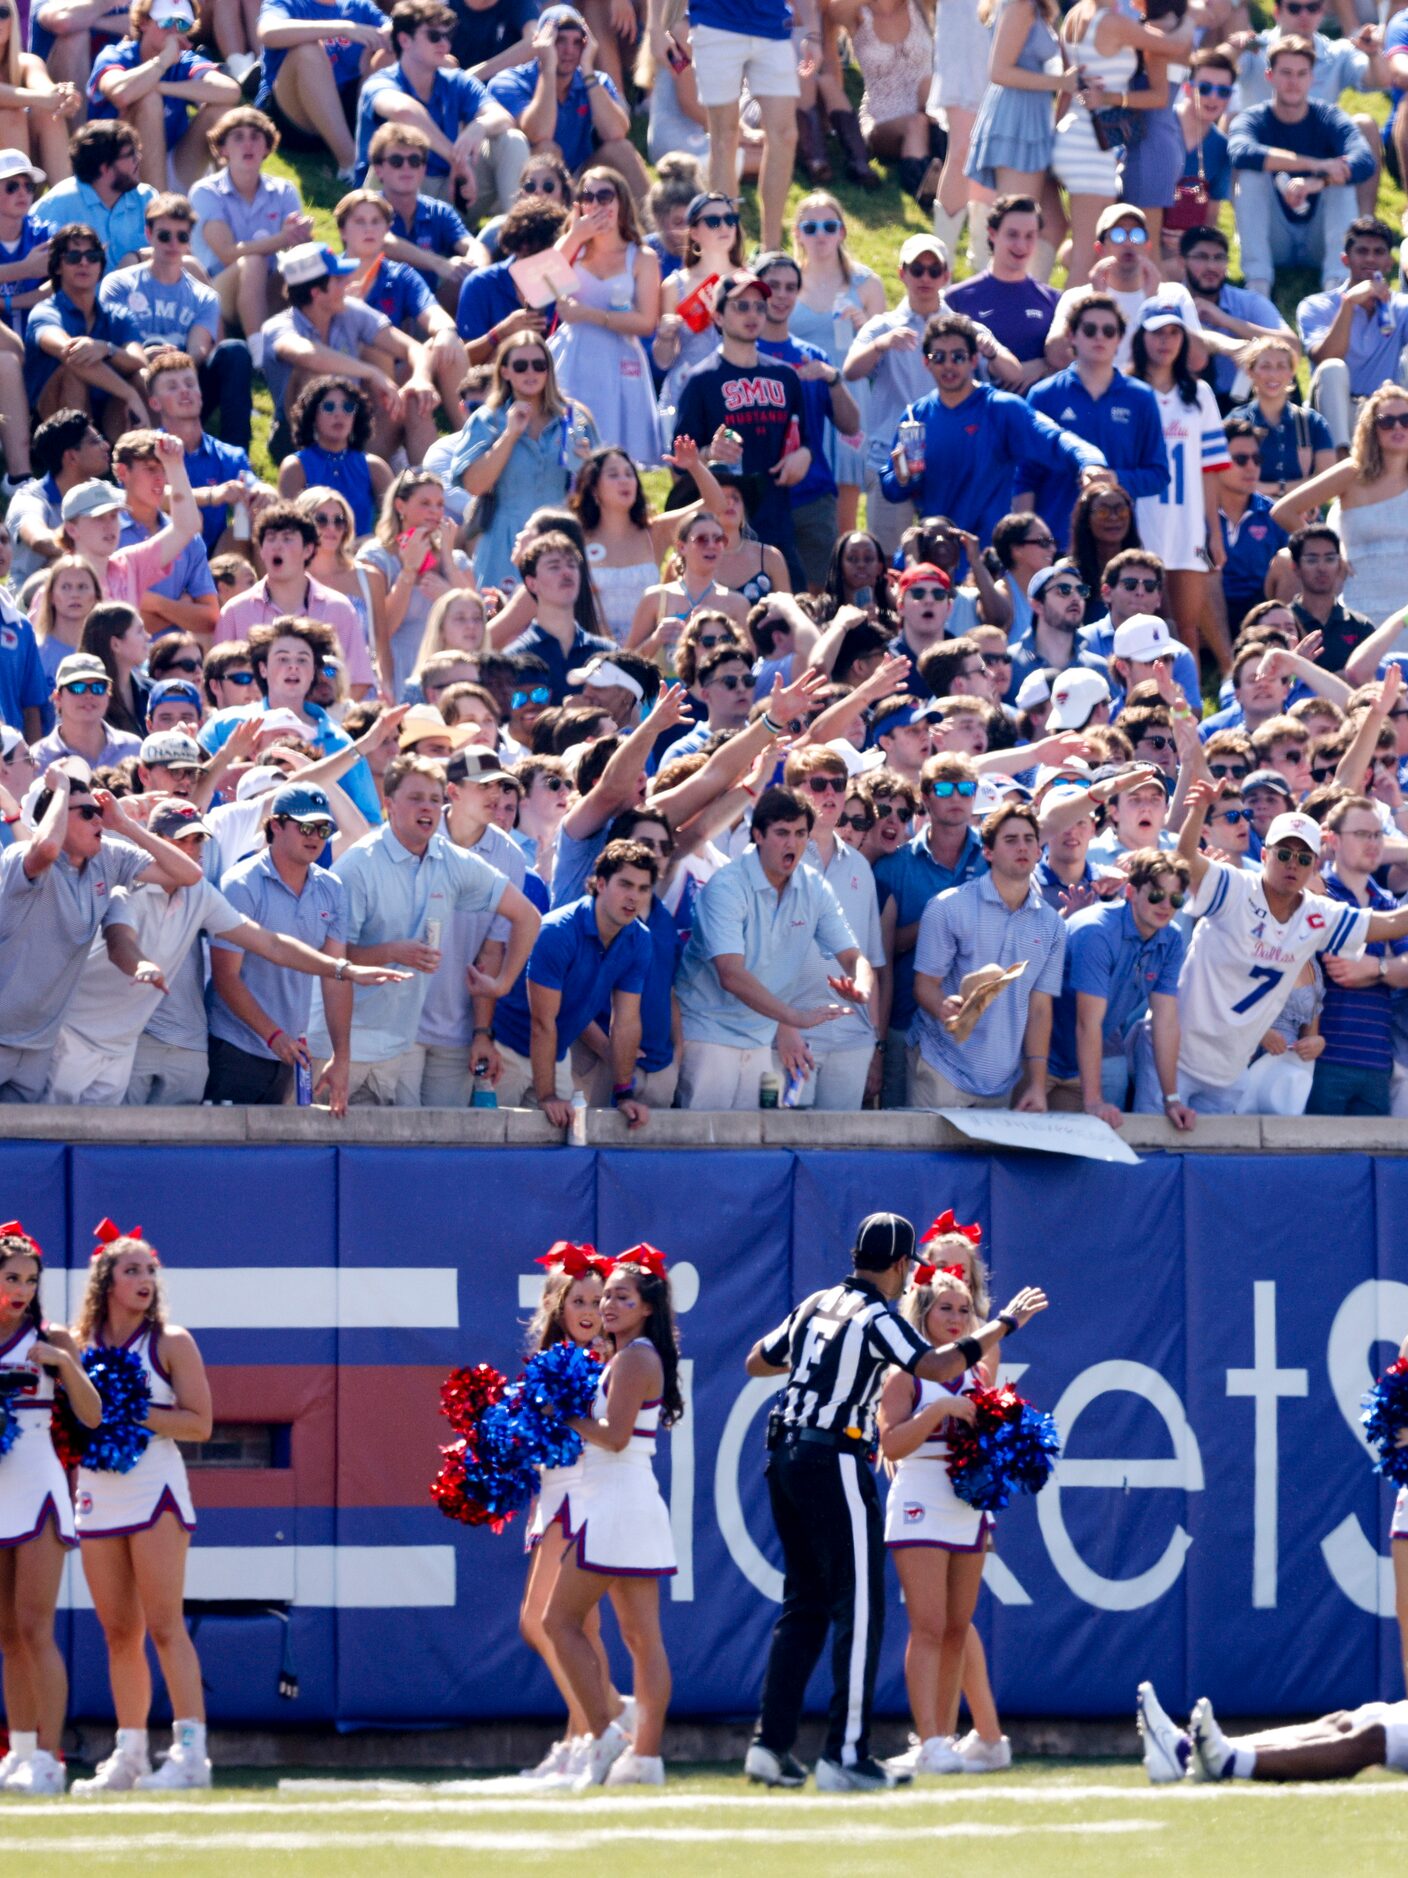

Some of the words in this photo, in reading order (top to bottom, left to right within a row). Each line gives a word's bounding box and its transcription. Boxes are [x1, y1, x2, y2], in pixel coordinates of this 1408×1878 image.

[722, 377, 786, 411] SMU
[1306, 913, 1325, 930] C
[1252, 941, 1296, 964] Dallas
[1231, 964, 1284, 1015] 7
[795, 1315, 841, 1383] F
